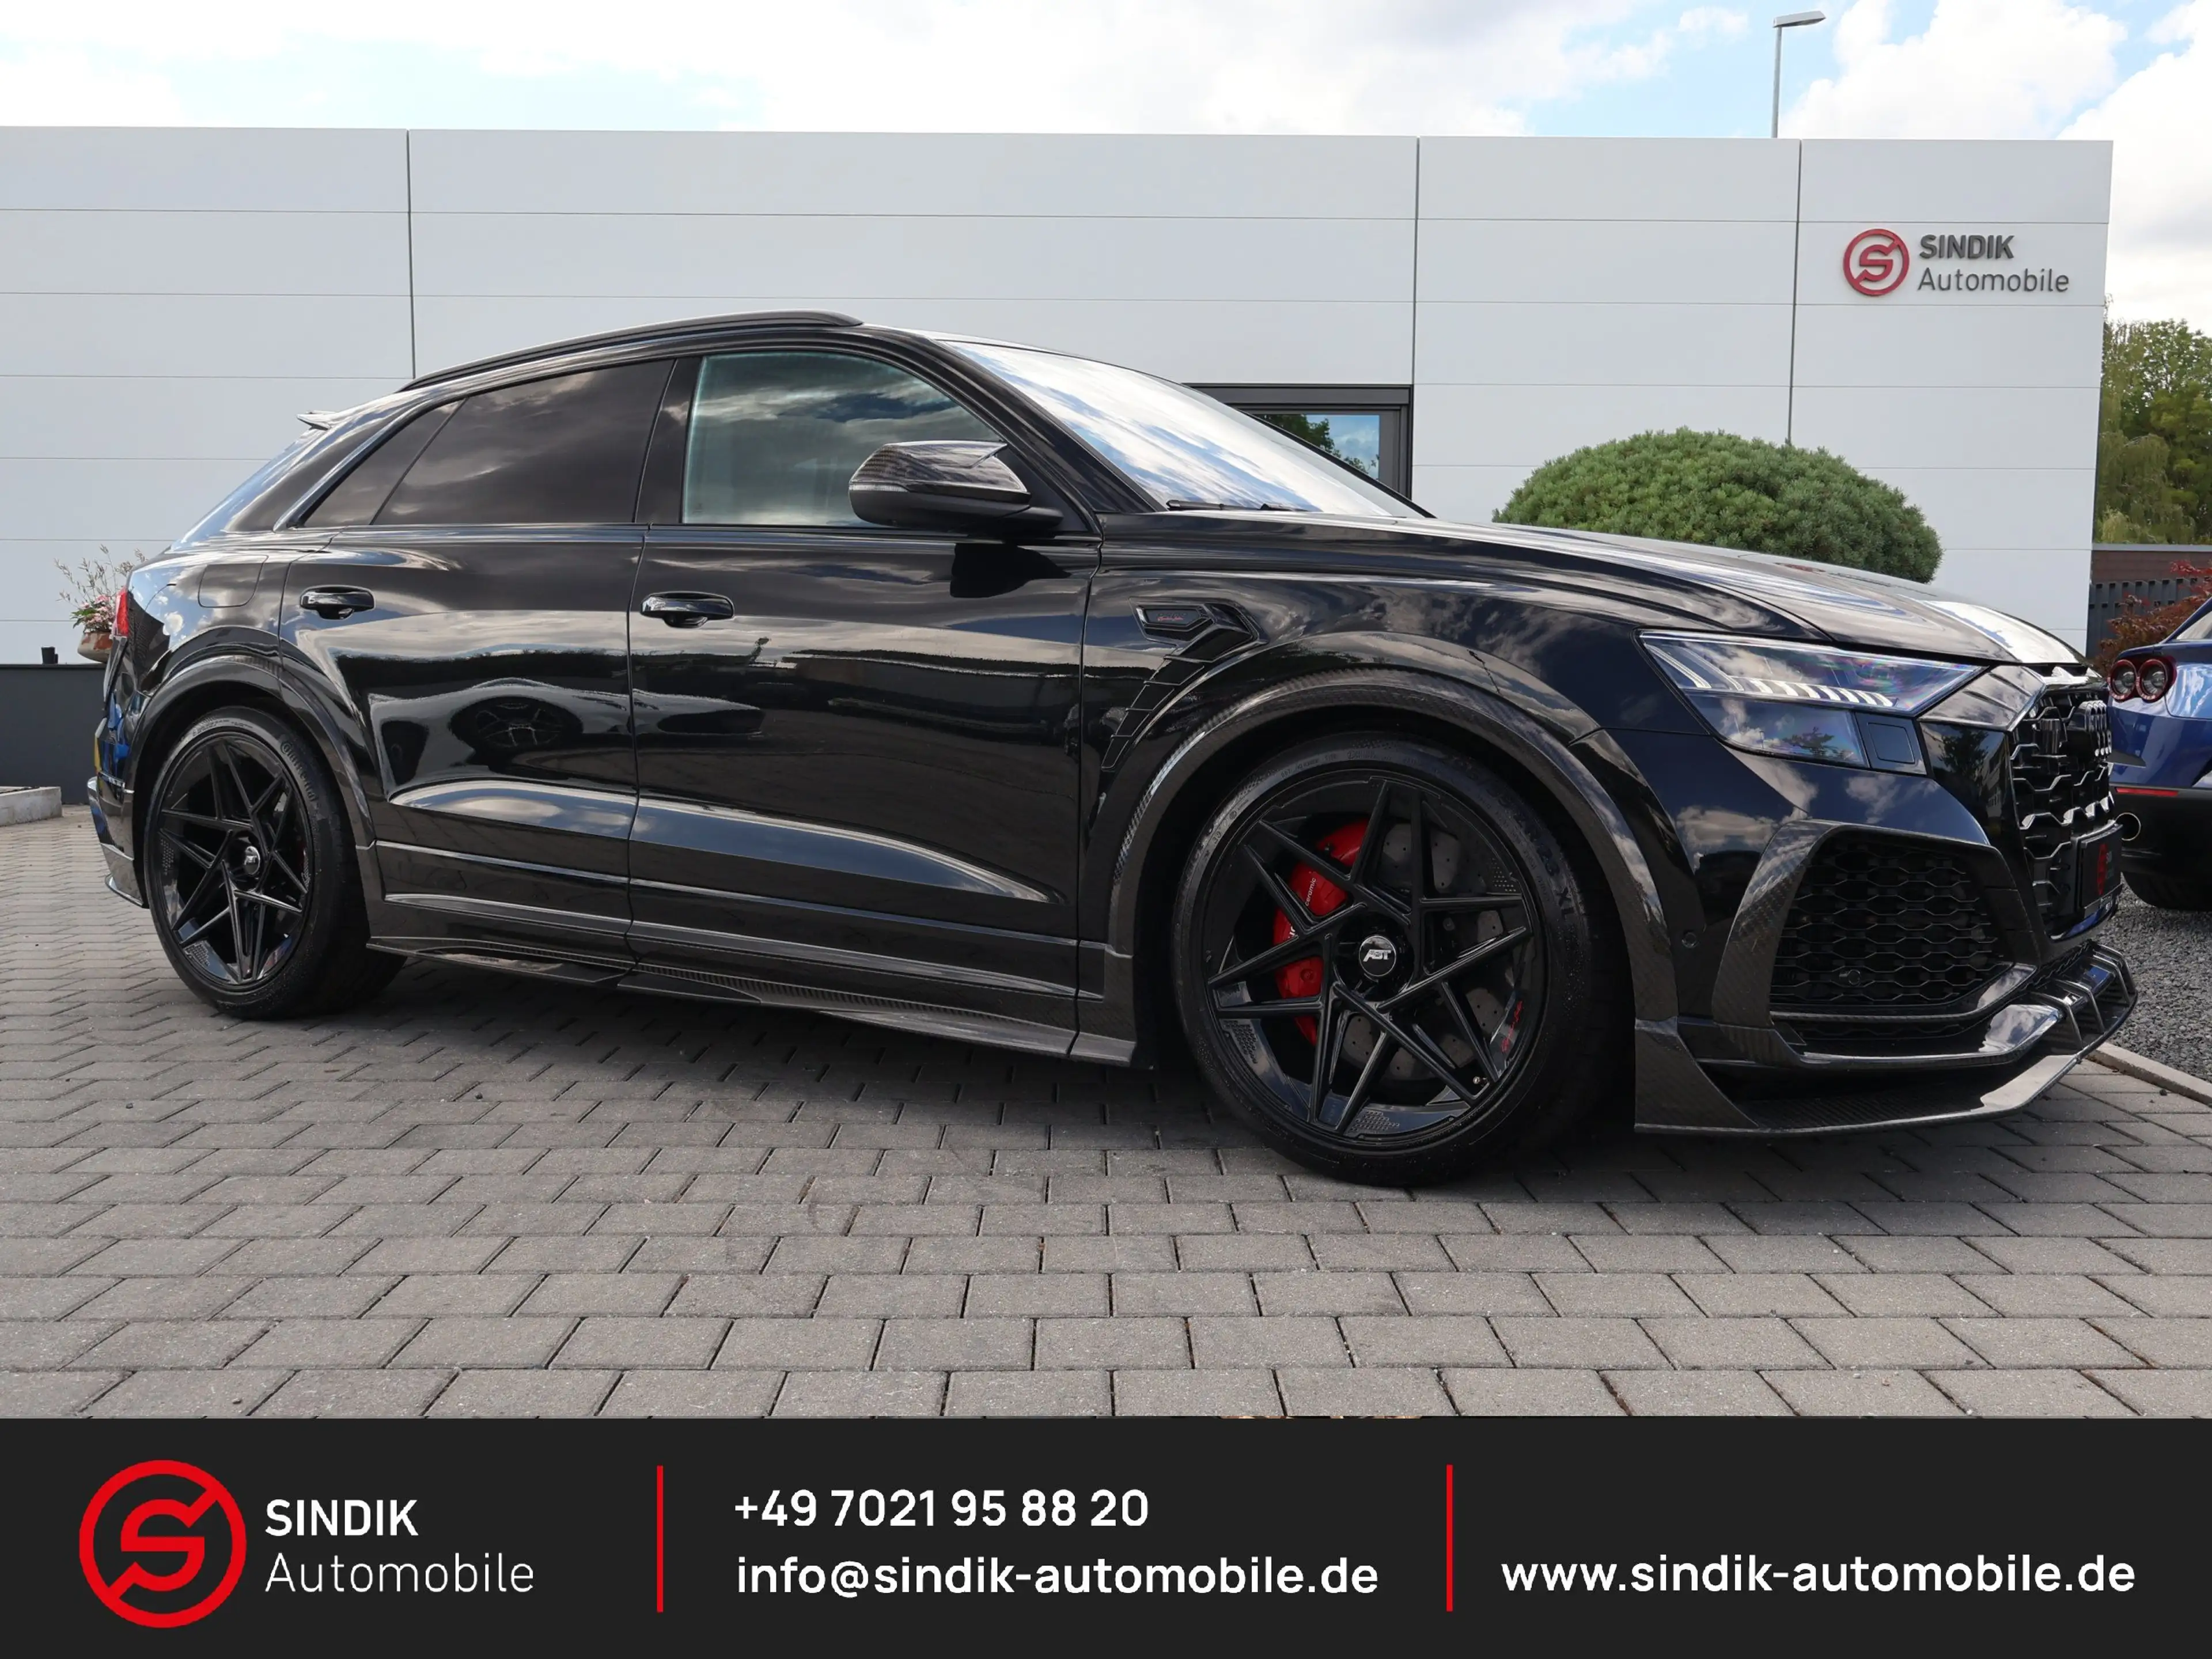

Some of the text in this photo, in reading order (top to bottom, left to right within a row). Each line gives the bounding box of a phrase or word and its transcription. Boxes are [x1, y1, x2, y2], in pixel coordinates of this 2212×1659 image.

[1919, 234, 2014, 259] SINDIK
[1918, 267, 2070, 293] Automobile
[1305, 877, 1316, 906] ceramic
[1363, 949, 1392, 962] ABT
